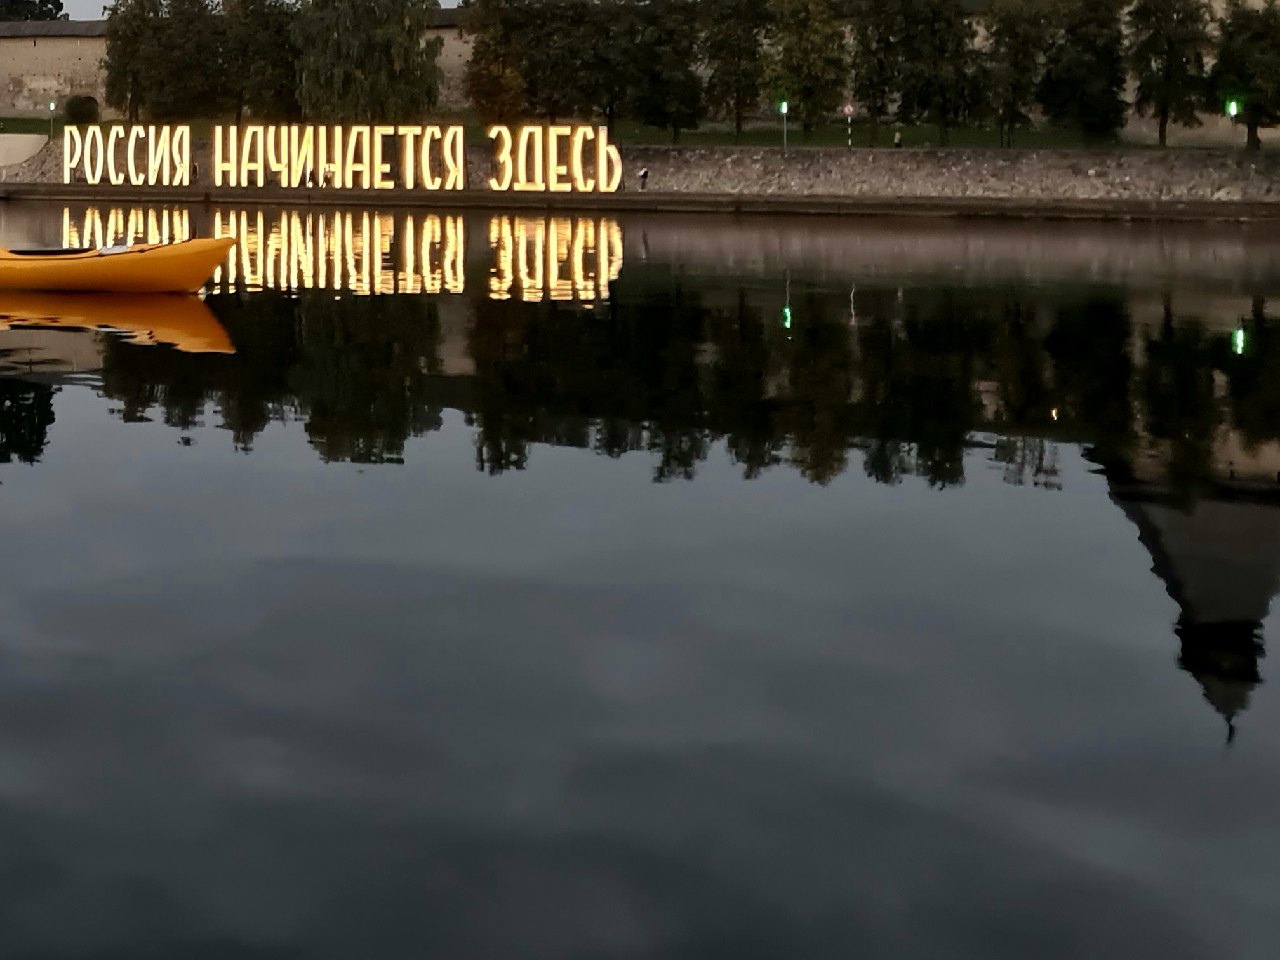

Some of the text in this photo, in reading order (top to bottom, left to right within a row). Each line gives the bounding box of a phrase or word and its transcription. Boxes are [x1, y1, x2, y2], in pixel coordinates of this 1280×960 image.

[63, 125, 623, 193] РОССИЯ НАЧИНАЕТСЯ ЗДЕСЬ
